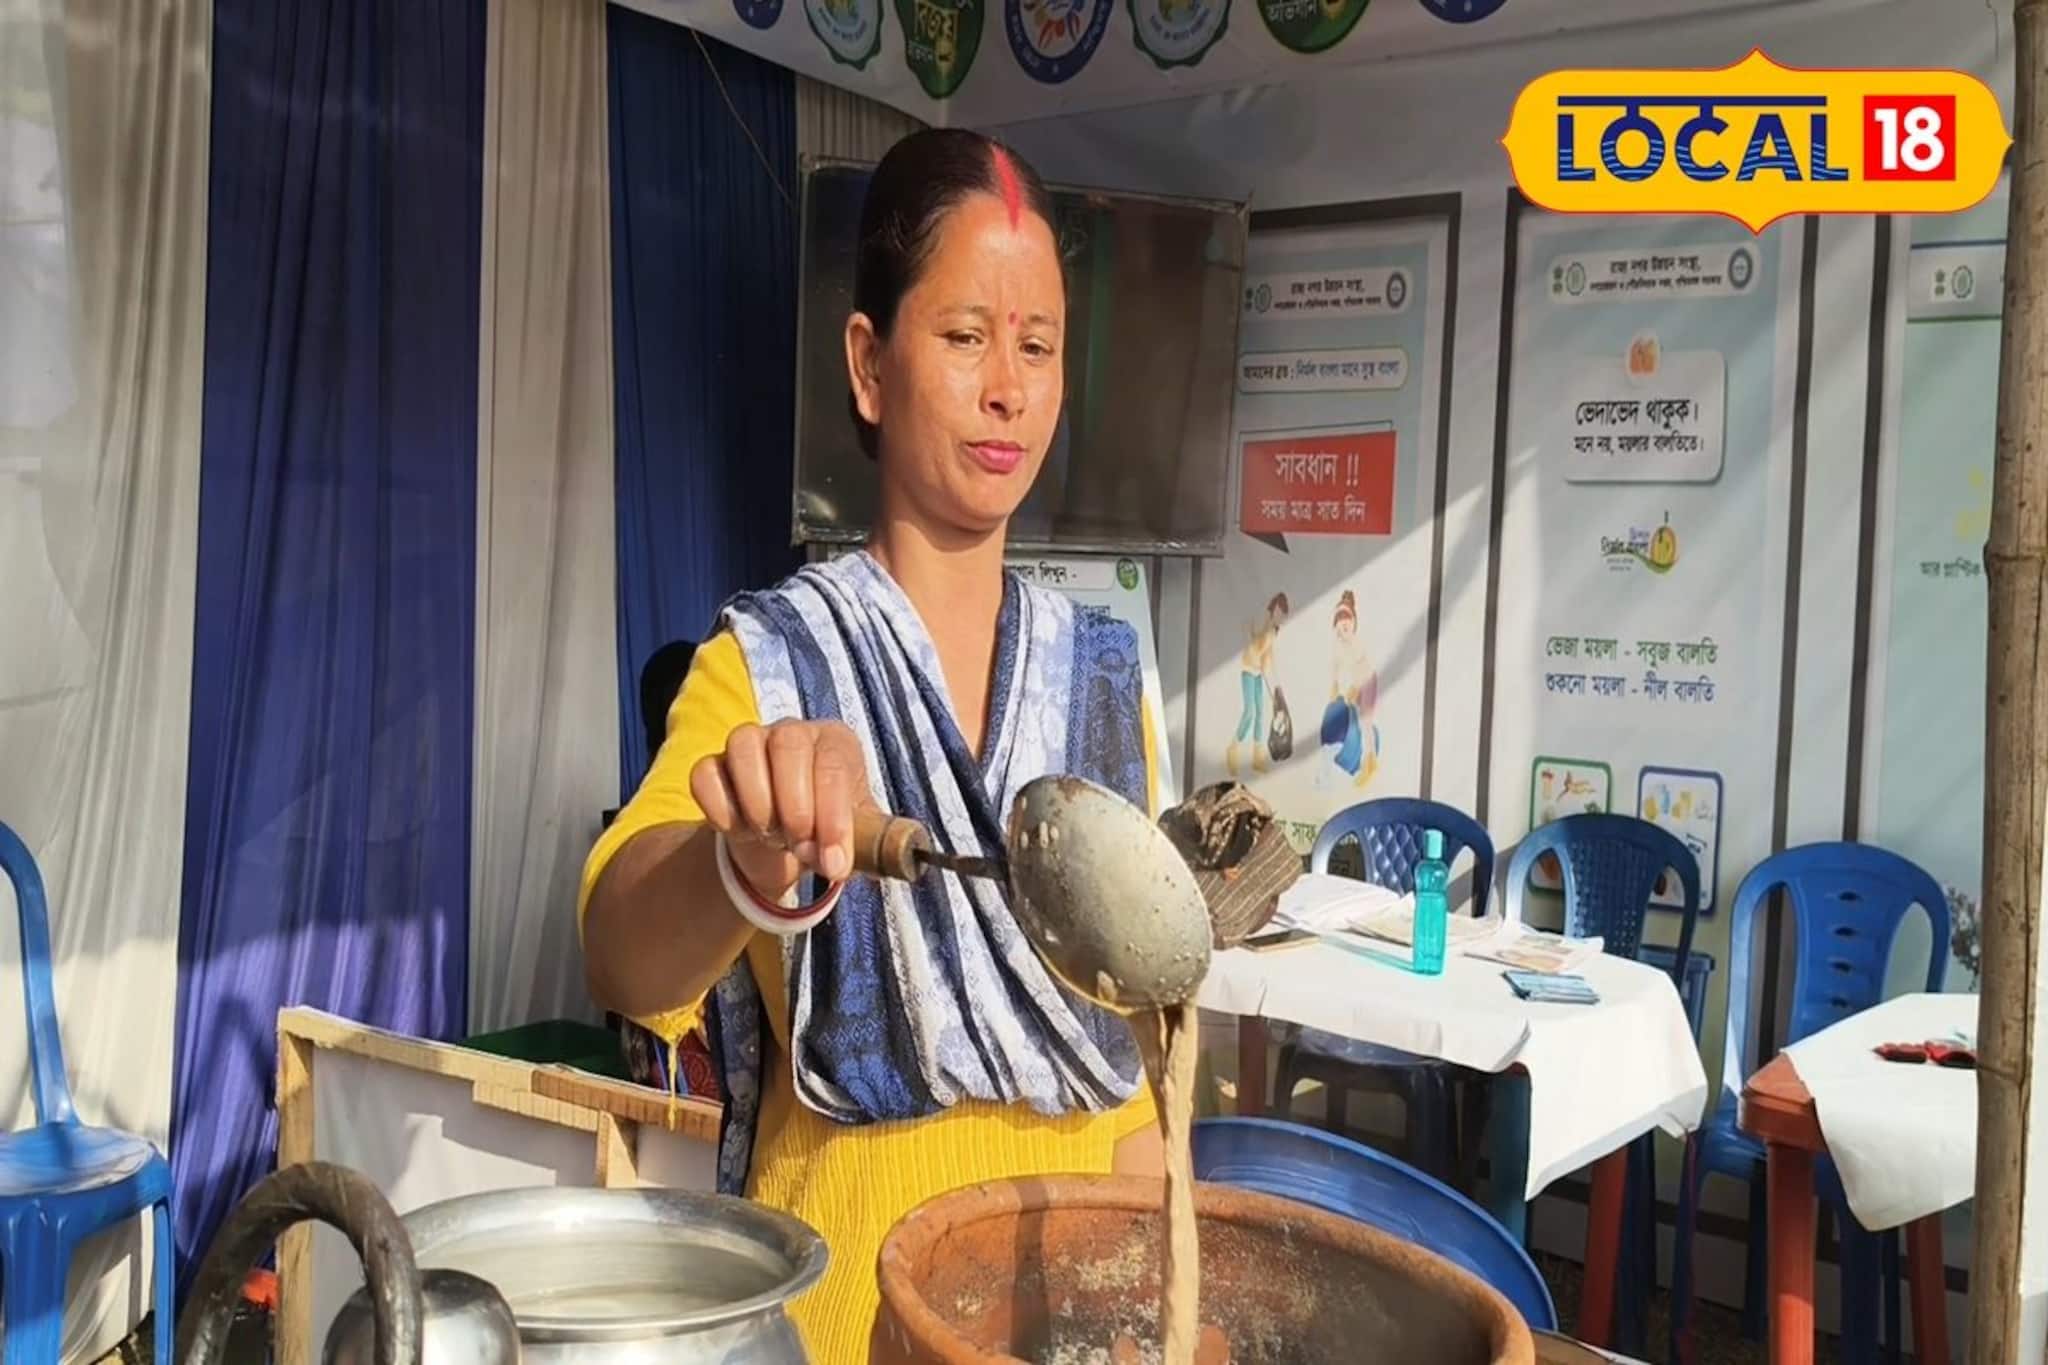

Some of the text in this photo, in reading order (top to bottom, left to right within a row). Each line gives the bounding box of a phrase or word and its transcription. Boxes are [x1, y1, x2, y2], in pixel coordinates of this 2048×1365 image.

[1576, 401, 1641, 425] ভেদাভেদ
[1275, 453, 1339, 485] সাবধান
[1261, 494, 1366, 522] সময় মাত্র সাত দিন
[1546, 636, 1579, 658] ভেজা
[1584, 638, 1618, 660] ময়লা
[1637, 640, 1671, 667] সবুজ
[1676, 636, 1718, 665] বালতি
[1545, 673, 1587, 695] শুকনো
[1592, 676, 1626, 698] ময়লা
[1644, 670, 1669, 700] নীল
[1673, 674, 1716, 702] বালতি
